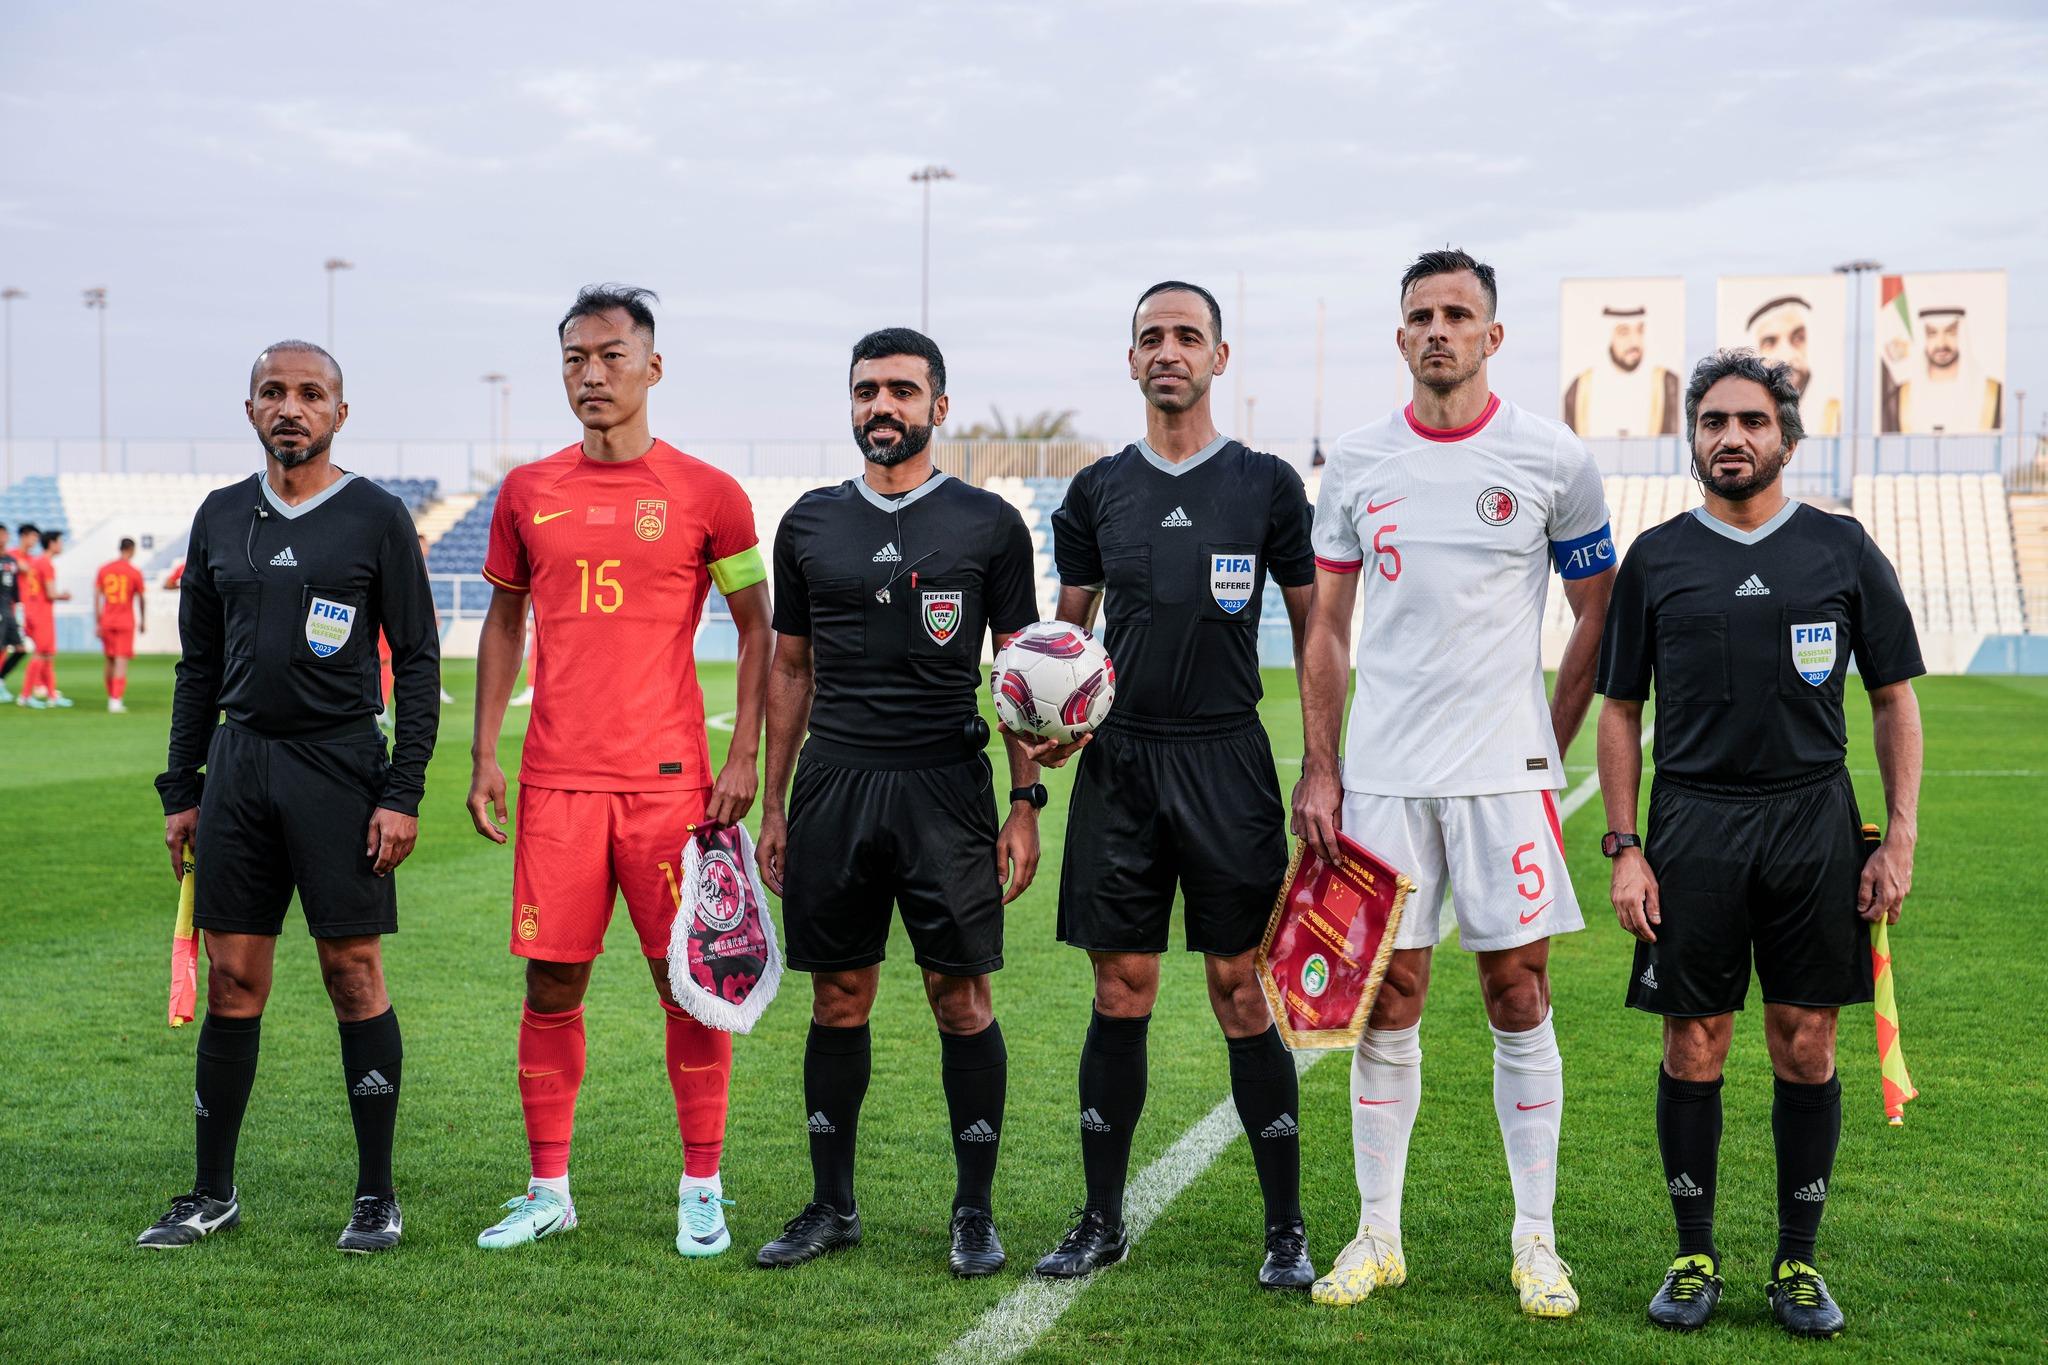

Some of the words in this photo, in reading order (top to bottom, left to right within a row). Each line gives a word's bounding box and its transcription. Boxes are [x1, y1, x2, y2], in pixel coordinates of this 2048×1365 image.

[639, 502, 664, 510] CFA
[1161, 519, 1192, 528] adidas
[1373, 524, 1402, 582] 5
[1565, 538, 1612, 570] AFC
[269, 559, 298, 567] adidas
[1216, 558, 1251, 572] FIFA
[103, 573, 129, 604] 21
[575, 559, 624, 614] 15
[1735, 587, 1770, 597] adidas
[1224, 600, 1241, 608] 2023
[313, 602, 349, 623] FIFA
[310, 621, 347, 636] ASSISTANT
[311, 628, 343, 641] REFEREE
[1796, 627, 1832, 644] FIFA
[314, 643, 332, 654] 2023
[1797, 648, 1832, 658] ASSISTANT
[1808, 672, 1825, 681] 2023
[707, 865, 726, 881] HK
[1511, 841, 1545, 901] 5
[714, 901, 734, 917] FA
[1640, 975, 1658, 990] adidas
[353, 1083, 394, 1097] adidas
[808, 1123, 836, 1134] didas
[960, 1132, 997, 1143] adidas
[1794, 1190, 1827, 1202] adida
